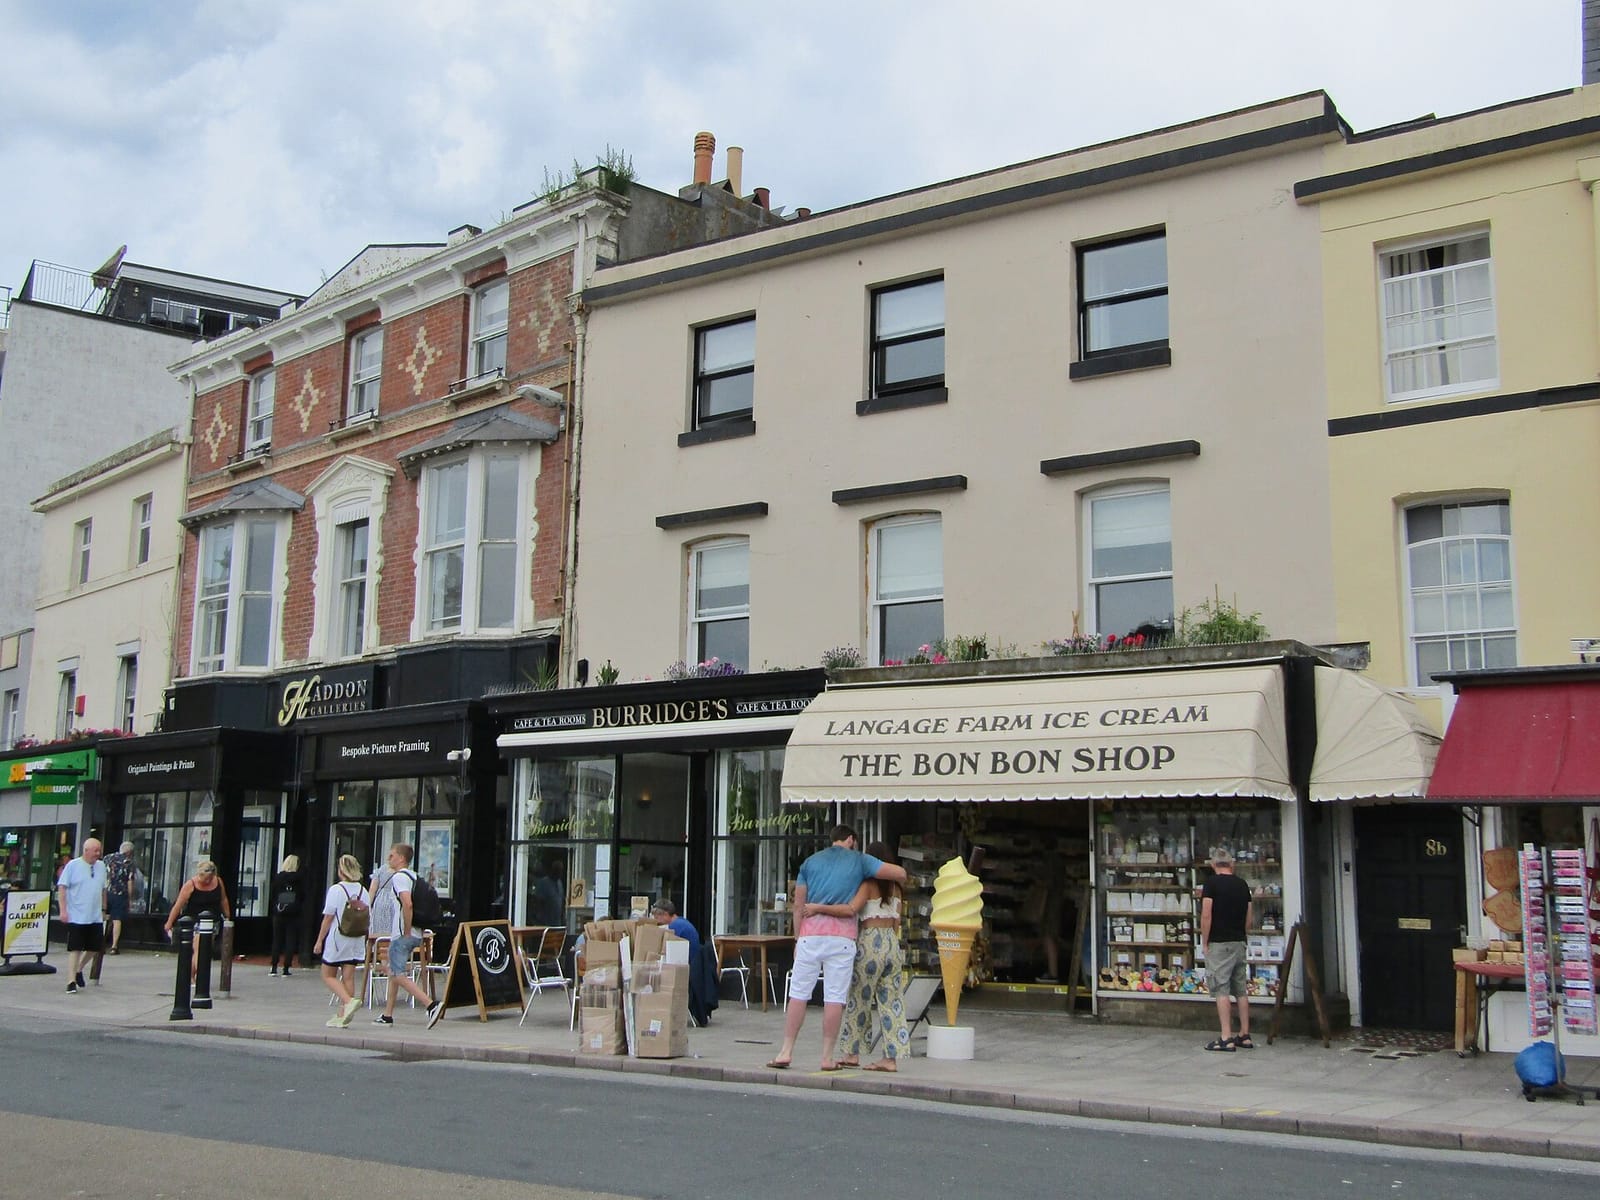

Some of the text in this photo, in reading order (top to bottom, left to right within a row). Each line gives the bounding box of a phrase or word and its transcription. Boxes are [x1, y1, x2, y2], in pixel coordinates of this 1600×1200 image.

[278, 675, 367, 726] HADDON
[736, 699, 813, 713] CAFE & TEA ROO
[310, 701, 366, 715] GALLERIES
[592, 698, 728, 728] BURRIDGE'S
[514, 714, 586, 728] CAFE & TEA ROOMS
[824, 705, 1208, 736] LANGAGE FARM ICE CREAM
[342, 739, 430, 758] Bespoke Picture Framing
[128, 760, 195, 775] Original Paintings & Prints
[840, 745, 1175, 777] THE BON BON SHOP
[35, 785, 75, 793] SUBWAY
[1426, 839, 1447, 856] 8b
[20, 903, 37, 911] ART
[8, 912, 47, 920] GALLERY
[15, 921, 39, 930] OPEN
